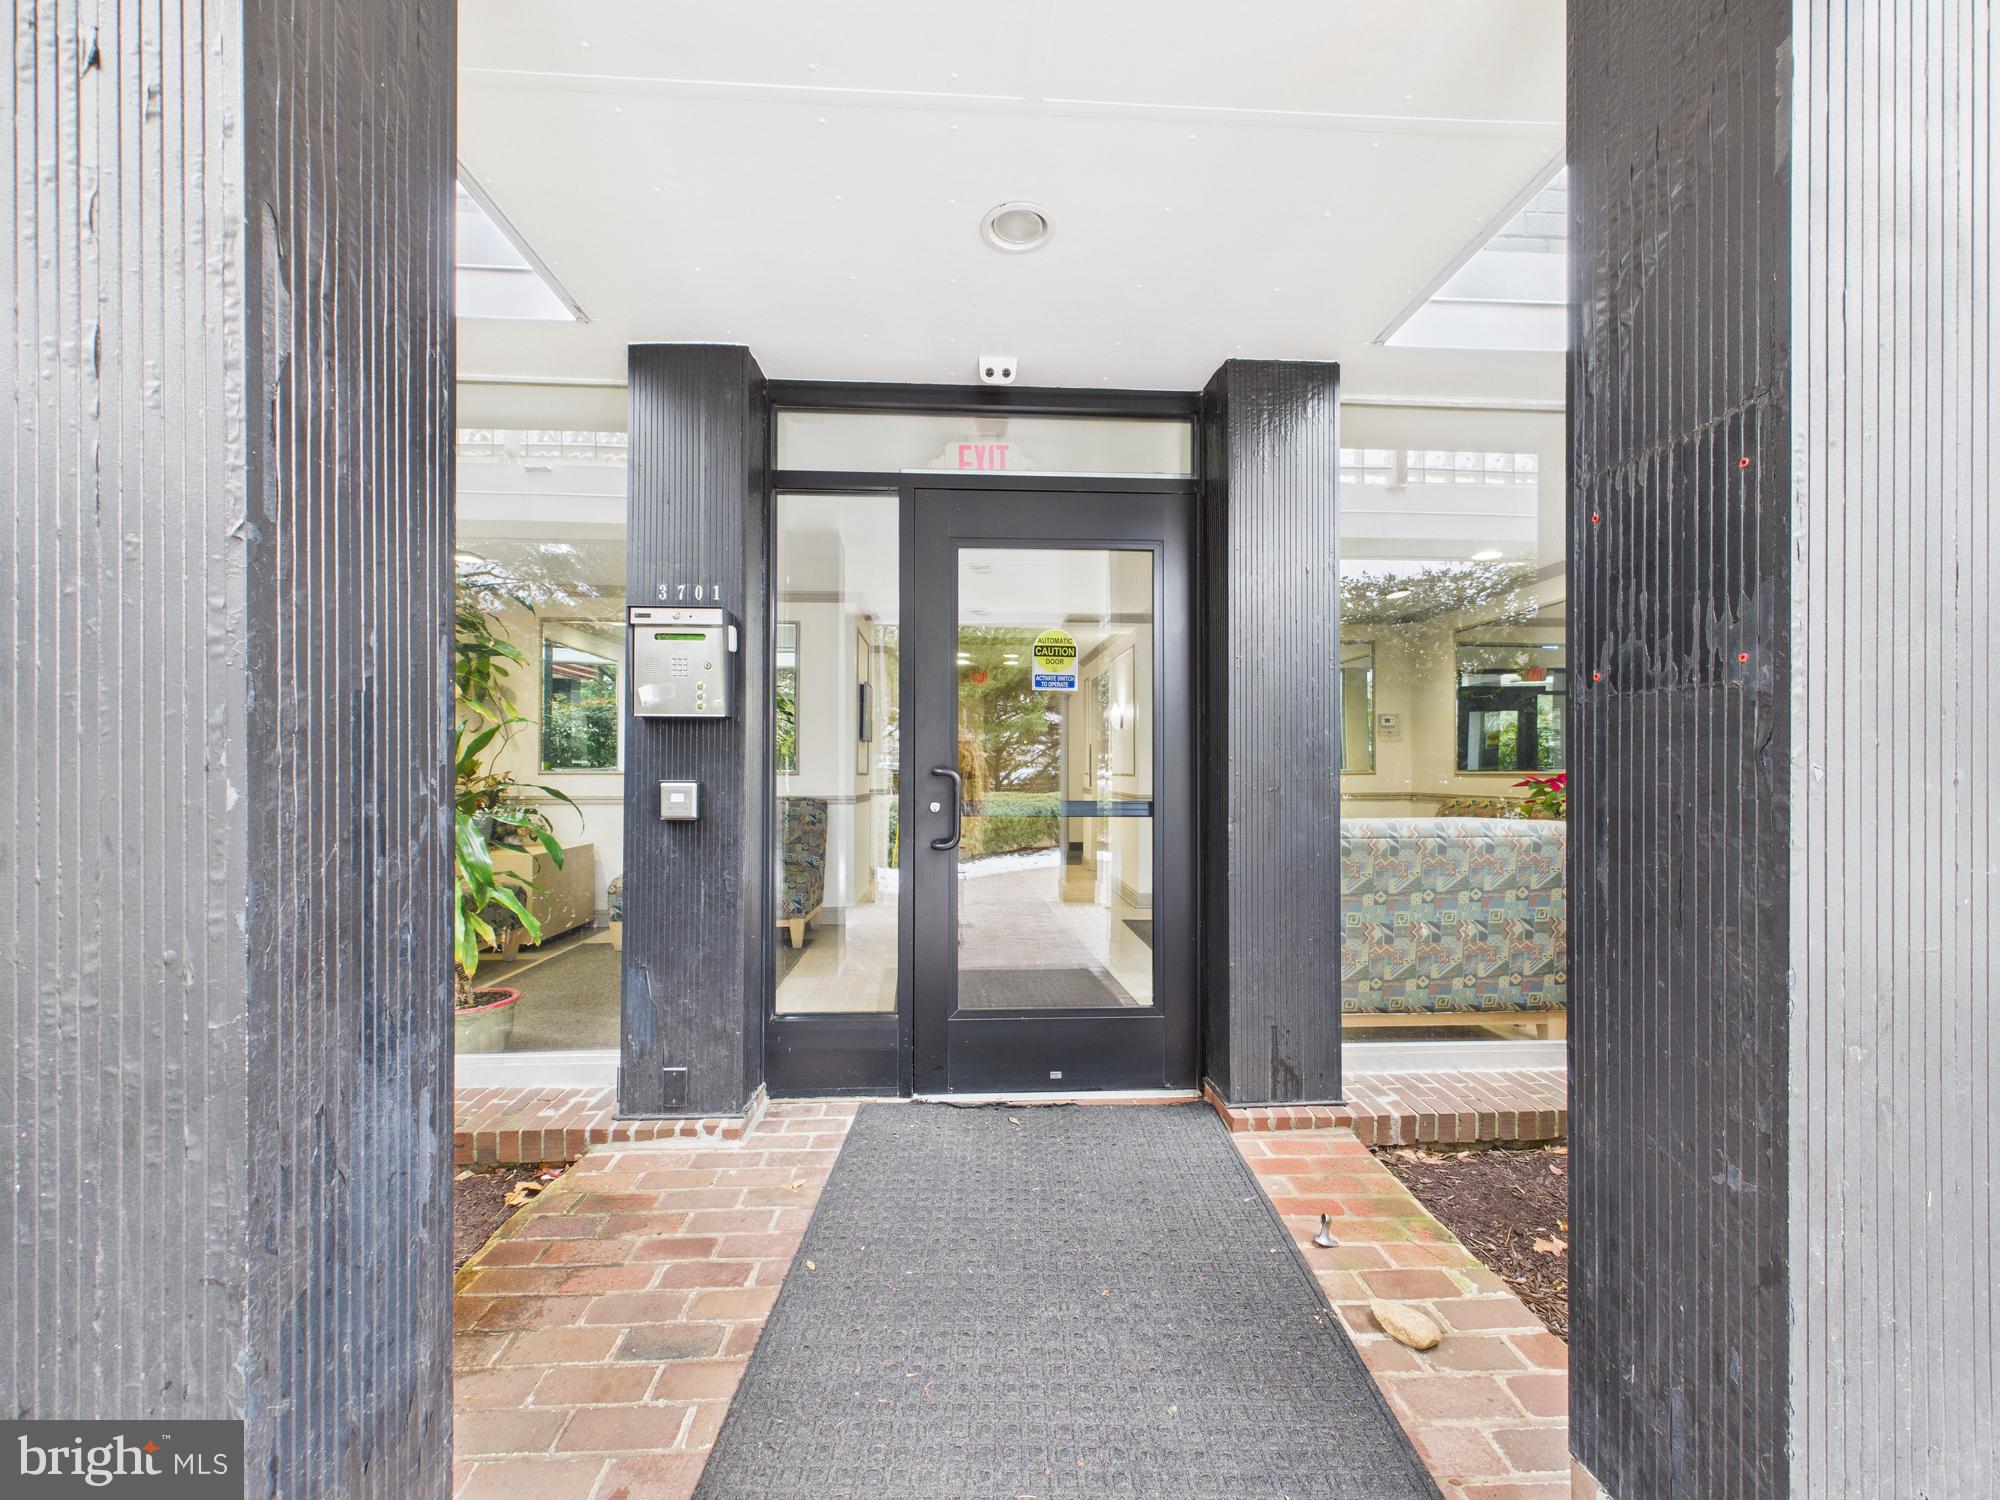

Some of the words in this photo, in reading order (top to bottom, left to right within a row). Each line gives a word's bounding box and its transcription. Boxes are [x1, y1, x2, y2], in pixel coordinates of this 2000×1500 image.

[958, 444, 1009, 471] EXIT
[658, 584, 720, 601] 3701
[1037, 637, 1073, 645] AUTOMATIC
[1035, 646, 1075, 656] CAUTION
